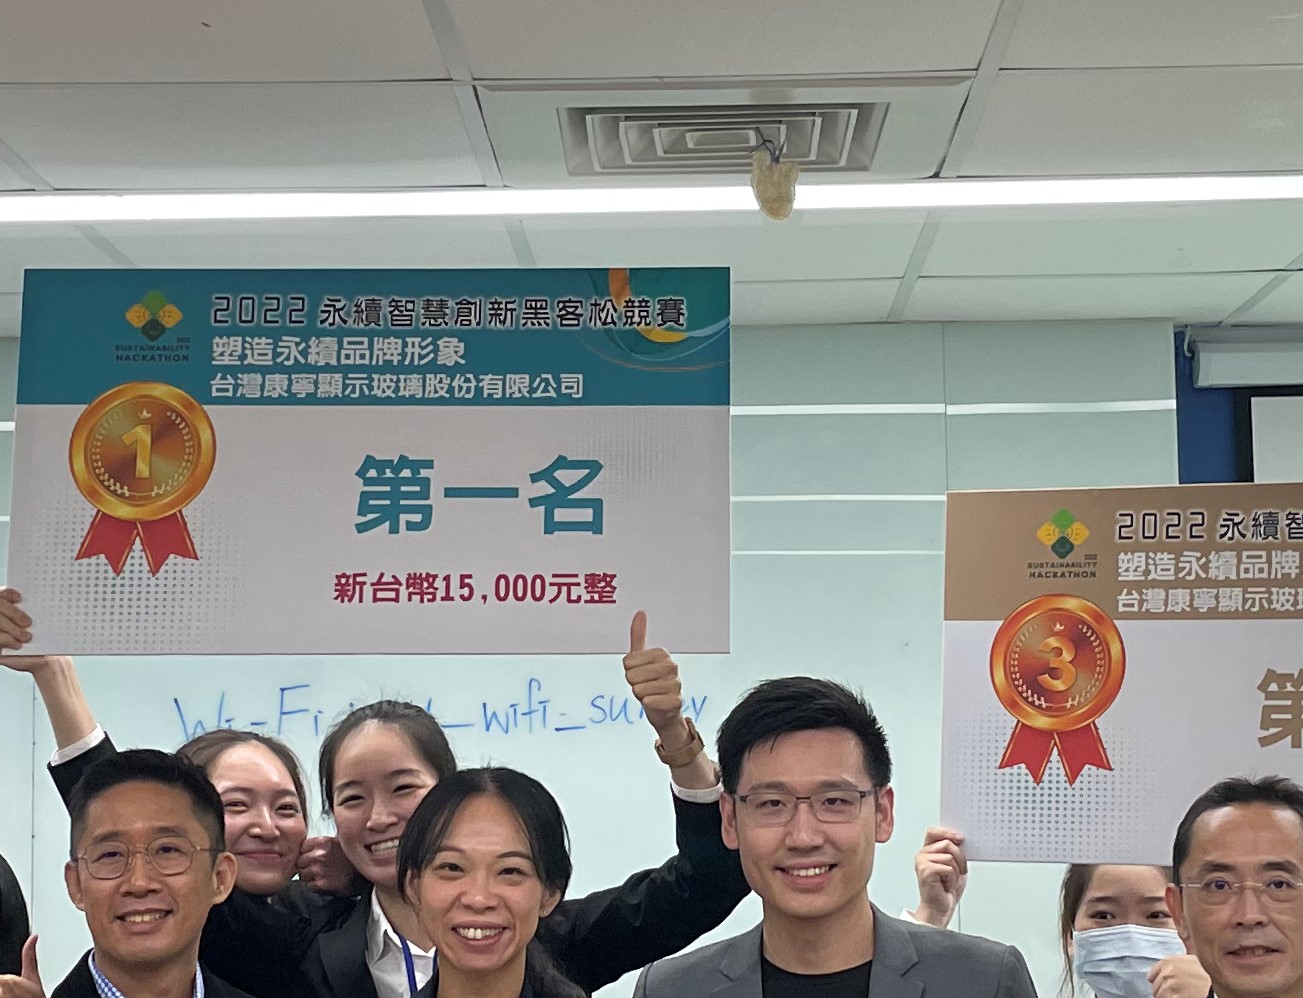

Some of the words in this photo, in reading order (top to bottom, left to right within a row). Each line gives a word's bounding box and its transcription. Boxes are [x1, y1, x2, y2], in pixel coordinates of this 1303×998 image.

[212, 295, 306, 325] 2022
[319, 297, 686, 328] 永續智慧創新黑客松競賽
[210, 336, 466, 366] 塑造永續品牌形象
[209, 373, 584, 399] 台灣康寧顯示玻璃股份有限公司
[354, 454, 605, 535] 第一名
[1117, 511, 1206, 541] 2022
[333, 571, 618, 605] 新台幣15,000元整
[1037, 636, 1076, 692] 3
